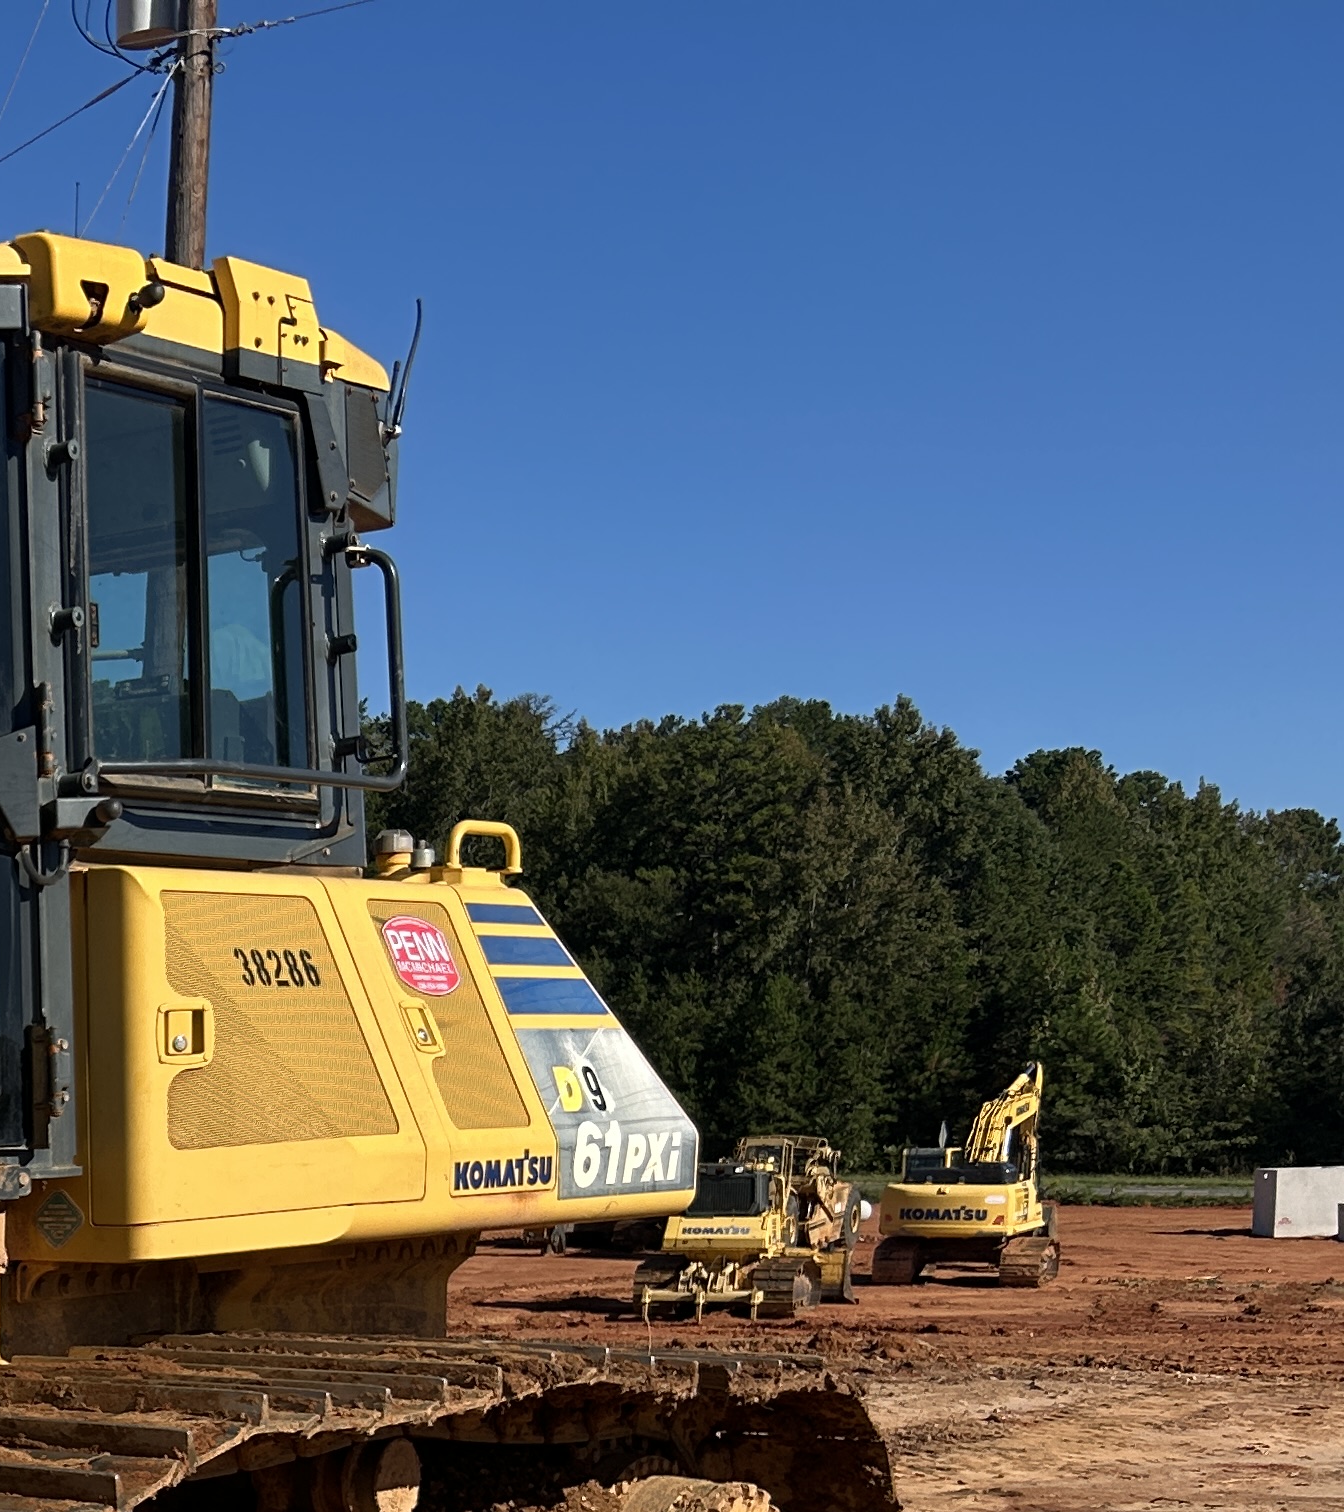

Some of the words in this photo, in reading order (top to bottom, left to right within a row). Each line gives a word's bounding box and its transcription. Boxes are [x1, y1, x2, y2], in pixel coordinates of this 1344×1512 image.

[385, 929, 450, 962] PENN
[233, 947, 321, 987] 38286
[454, 1149, 553, 1191] KOMATSU
[573, 1119, 682, 1189] 61PXi
[681, 1225, 750, 1235] KOMATSU
[899, 1206, 988, 1221] KOMATSU
